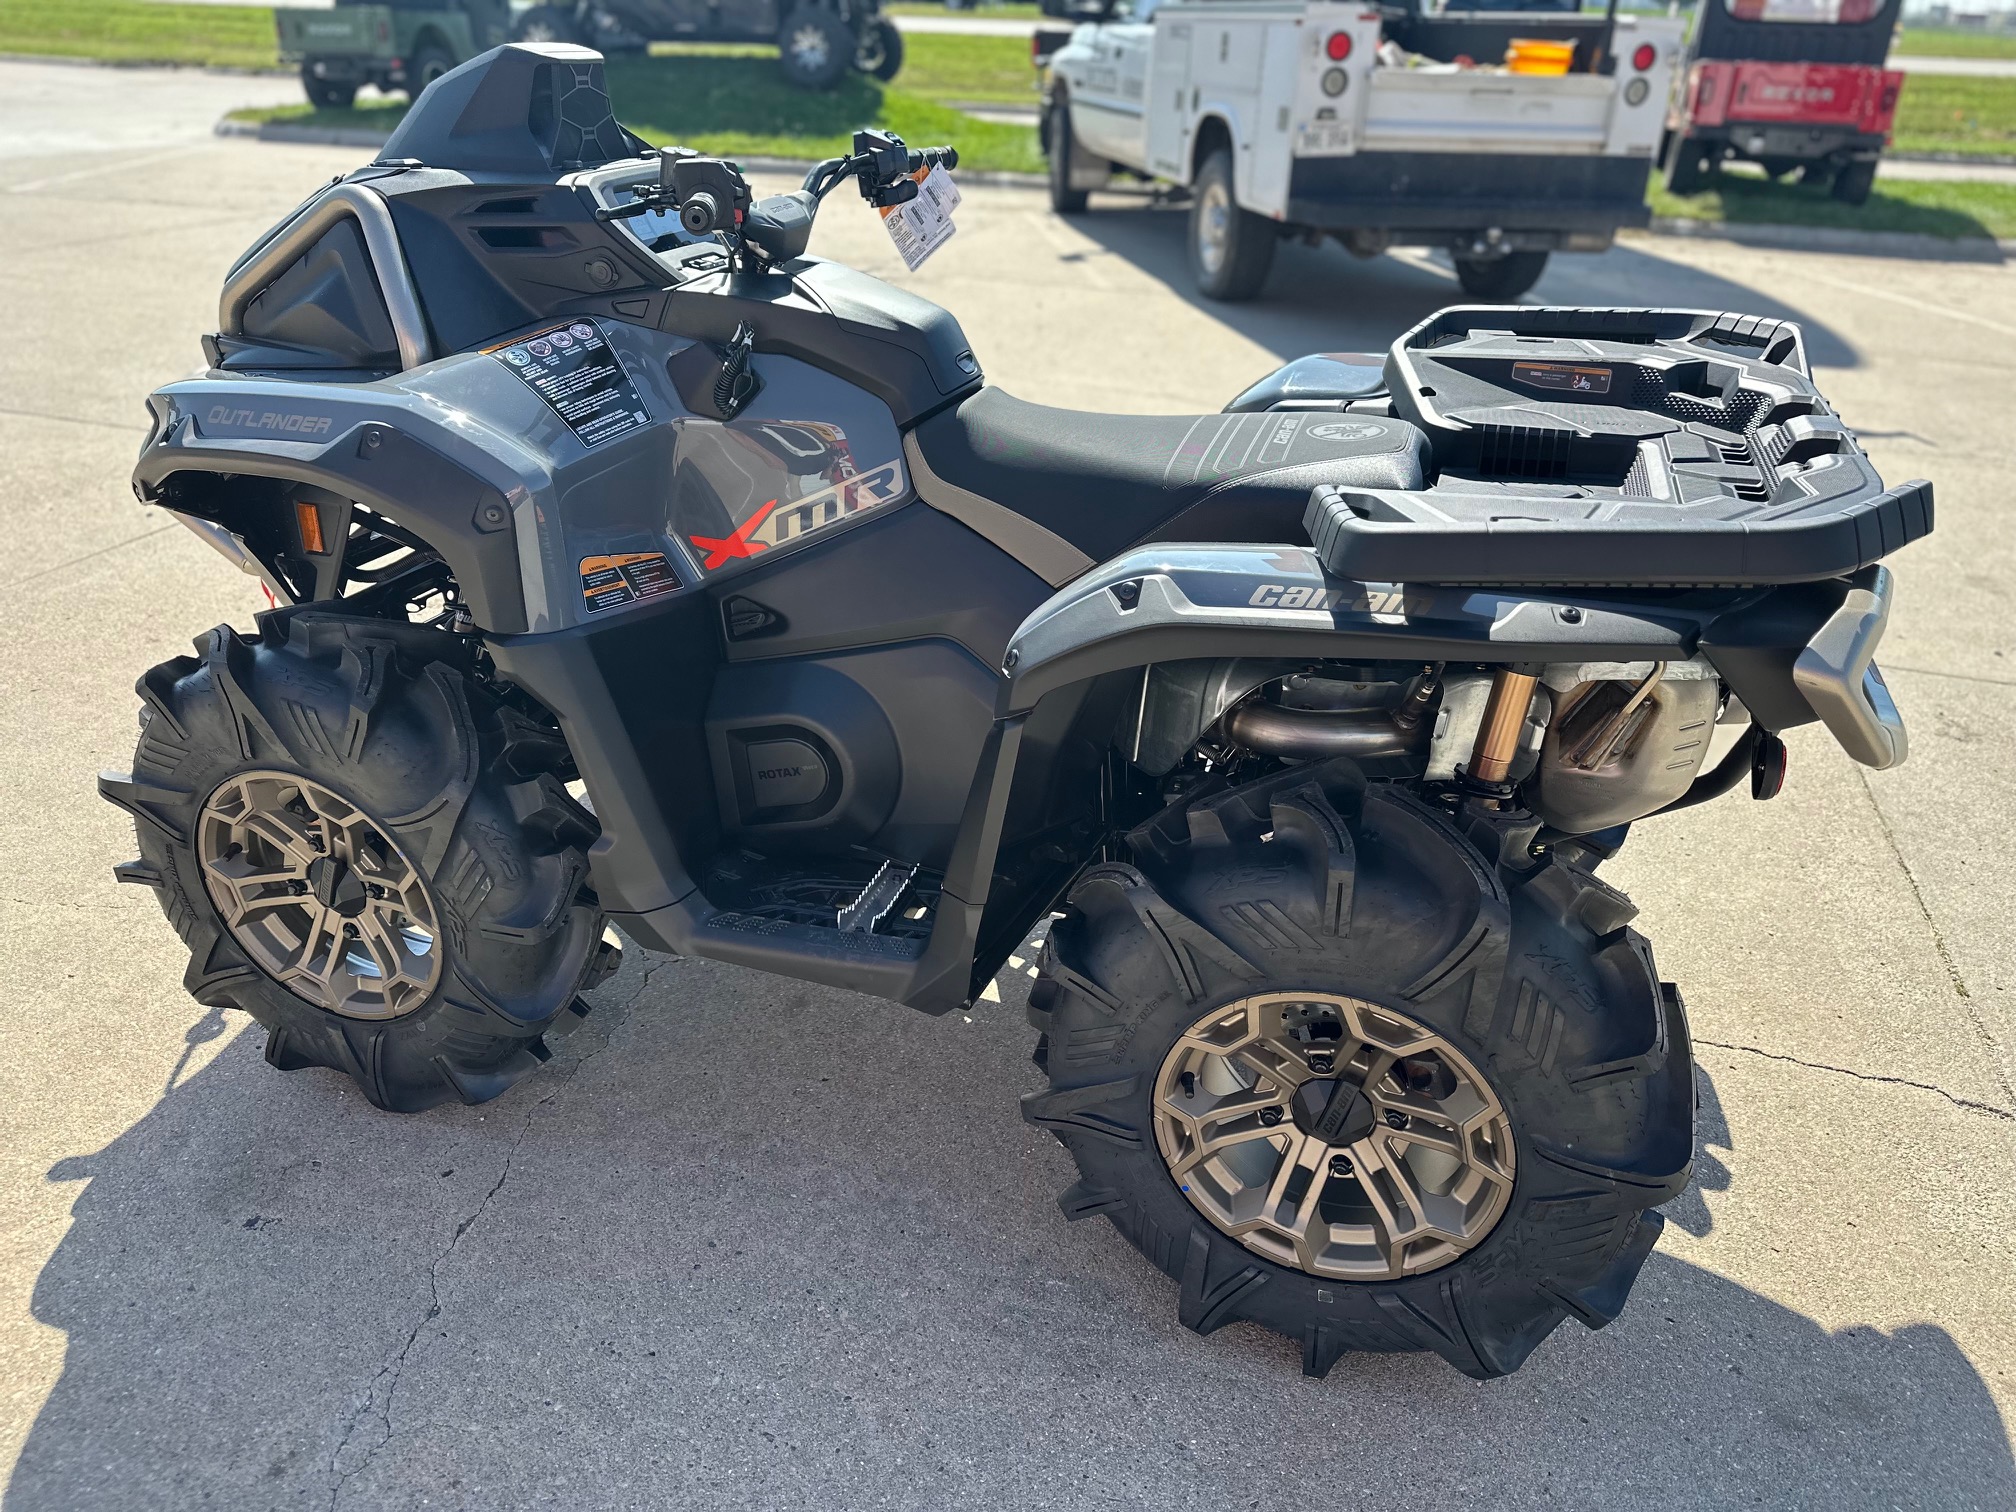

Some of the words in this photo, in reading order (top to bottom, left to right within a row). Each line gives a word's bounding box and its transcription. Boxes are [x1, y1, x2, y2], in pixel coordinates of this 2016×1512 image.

[207, 405, 333, 434] OUTLANDER
[1273, 418, 1299, 445] can-am
[1248, 584, 1436, 616] can-am
[758, 766, 801, 780] ROTAX
[1323, 1086, 1354, 1134] can-am
